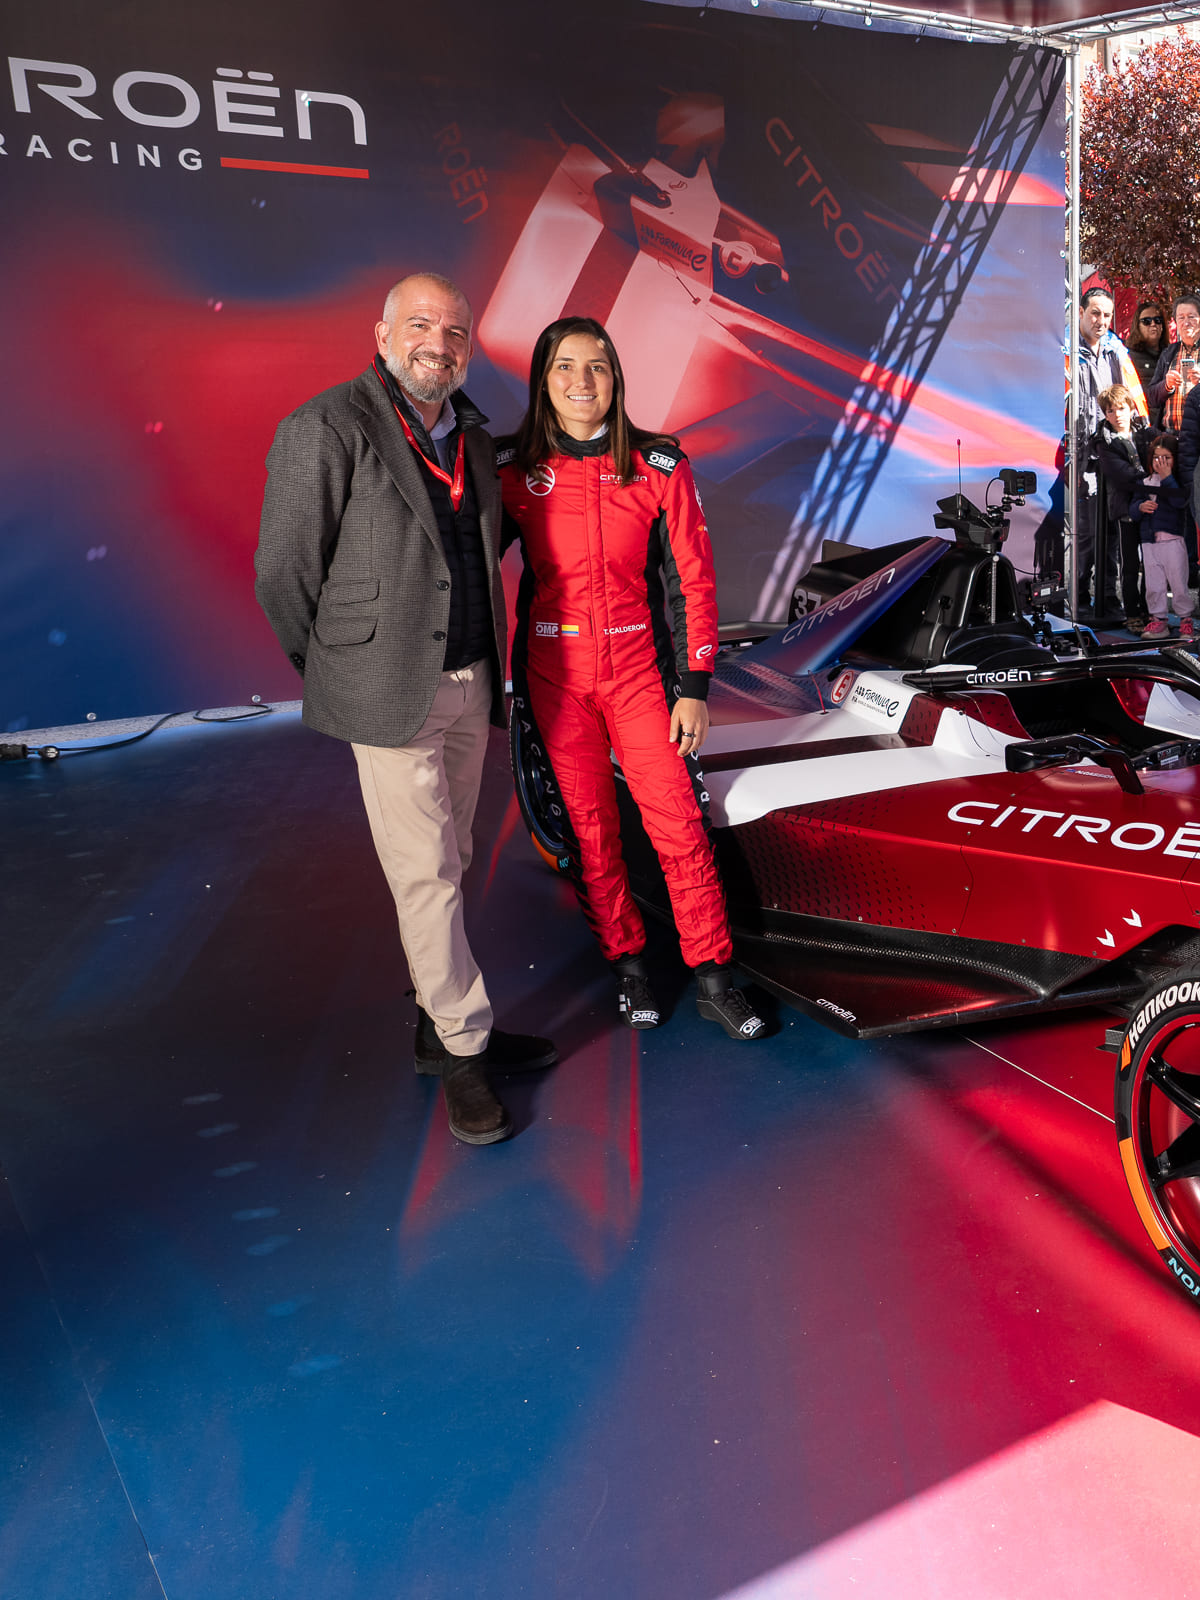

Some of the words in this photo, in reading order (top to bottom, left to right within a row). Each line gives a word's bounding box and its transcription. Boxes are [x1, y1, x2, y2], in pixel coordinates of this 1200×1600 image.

[649, 453, 676, 469] OMP
[795, 589, 821, 620] 37
[535, 624, 559, 635] OMP
